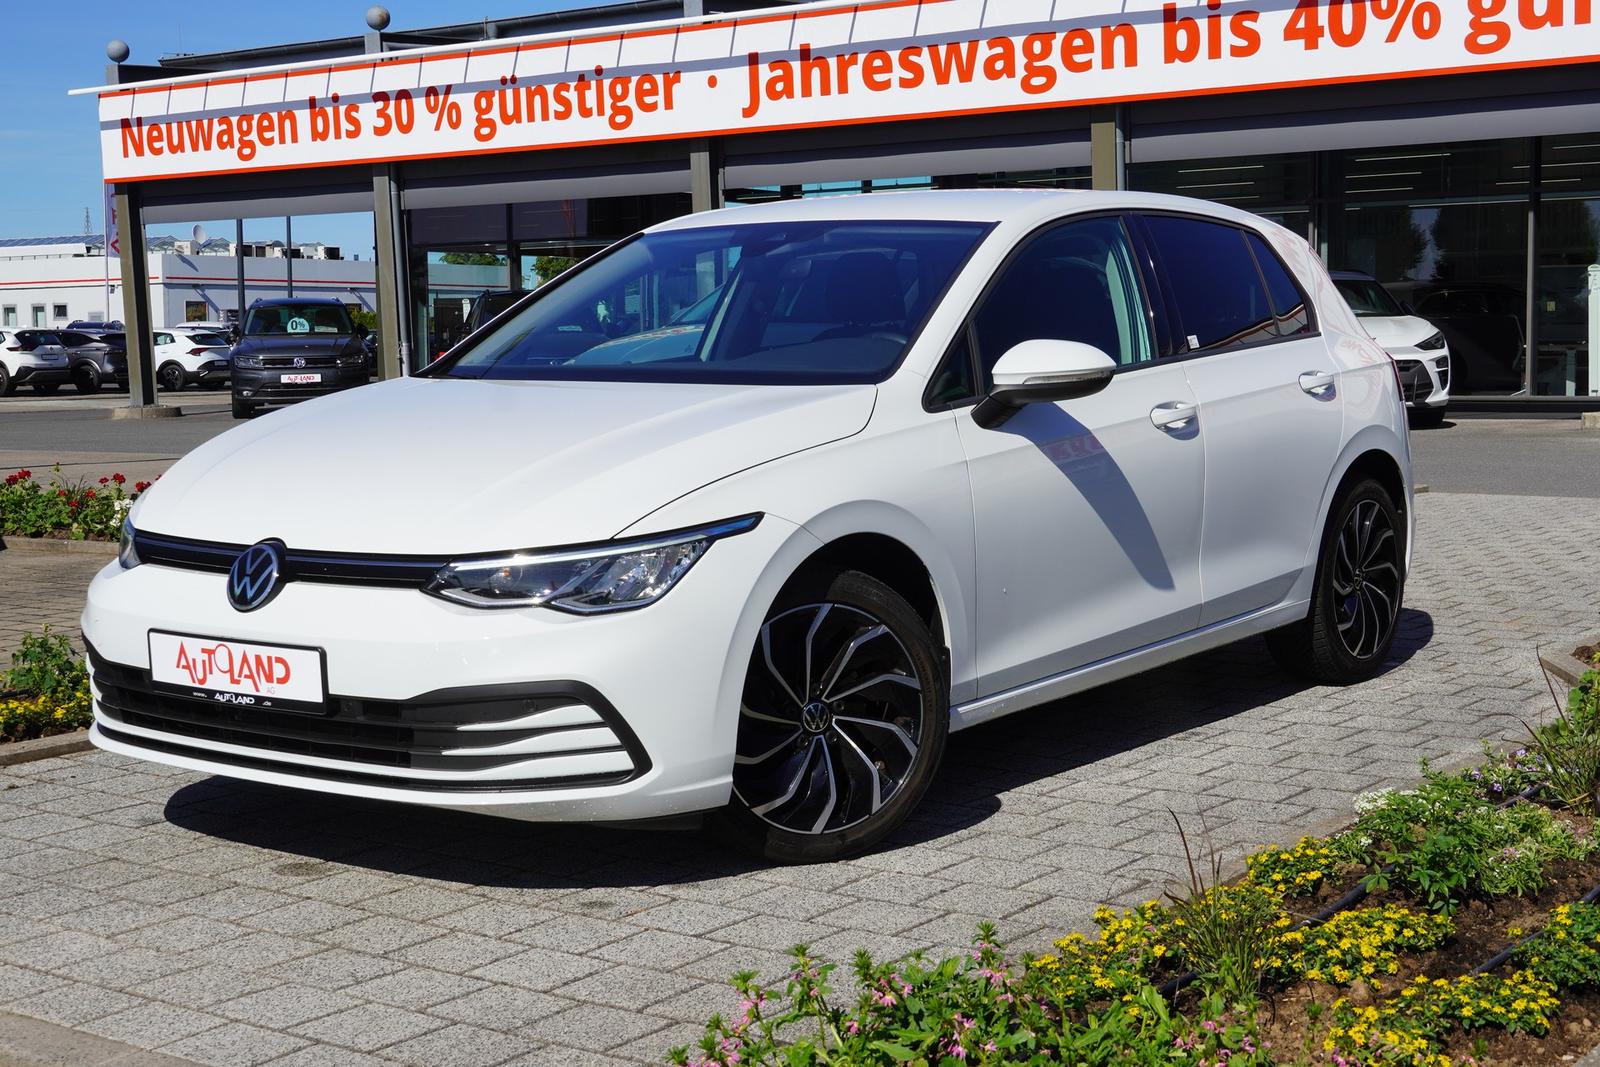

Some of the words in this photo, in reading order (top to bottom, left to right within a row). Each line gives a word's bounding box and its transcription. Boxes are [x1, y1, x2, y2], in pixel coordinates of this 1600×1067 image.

[120, 108, 299, 161] Neuwagen
[309, 92, 363, 143] bis
[372, 88, 415, 138] 30
[425, 86, 463, 132] %
[473, 65, 682, 142] günstiger
[741, 23, 1139, 118] Jahreswagen
[1162, 0, 1262, 65] bis
[1283, 0, 1442, 51] 40%
[290, 320, 305, 331] 0%
[176, 641, 291, 692] AUTOLAND
[214, 692, 255, 705] AUTOLAND
